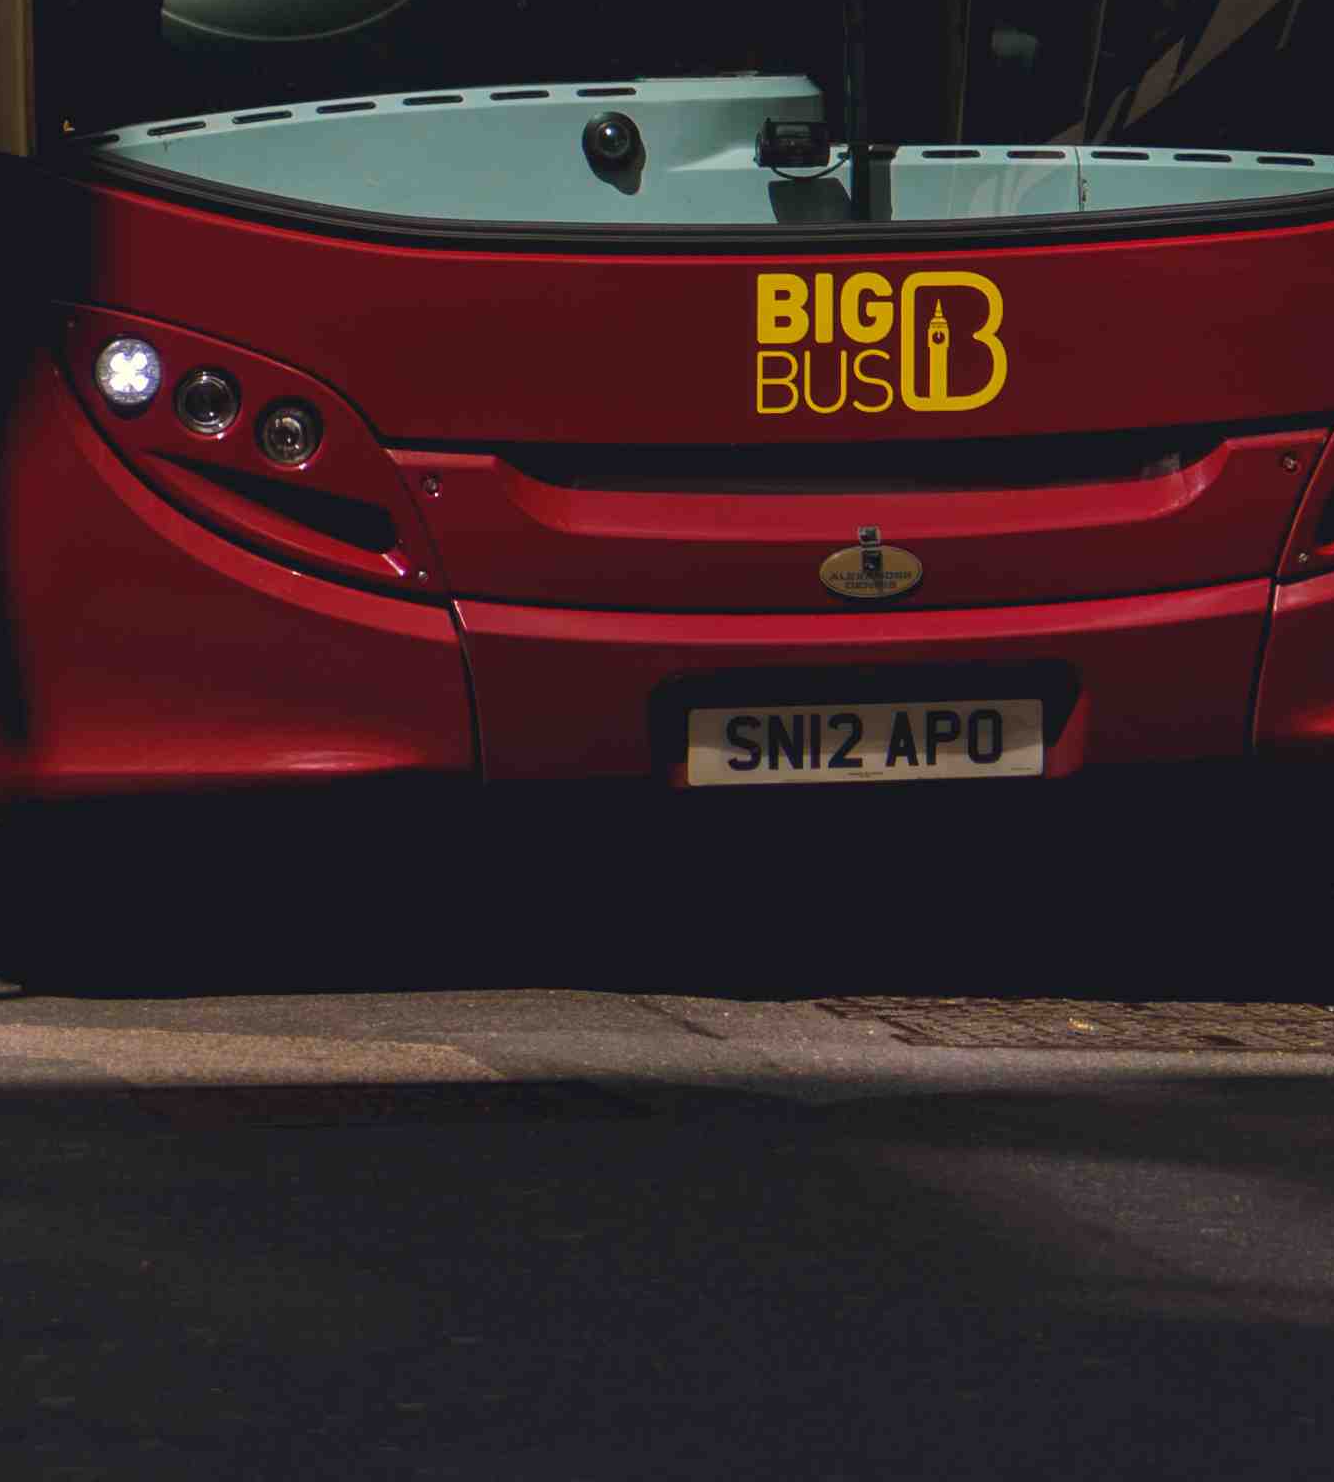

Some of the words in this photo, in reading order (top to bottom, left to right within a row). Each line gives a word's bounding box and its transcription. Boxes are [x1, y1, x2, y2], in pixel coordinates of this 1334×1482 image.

[756, 272, 894, 344] BIG
[756, 348, 895, 414] BUS
[726, 713, 864, 772] SN12
[885, 709, 1004, 768] APO
